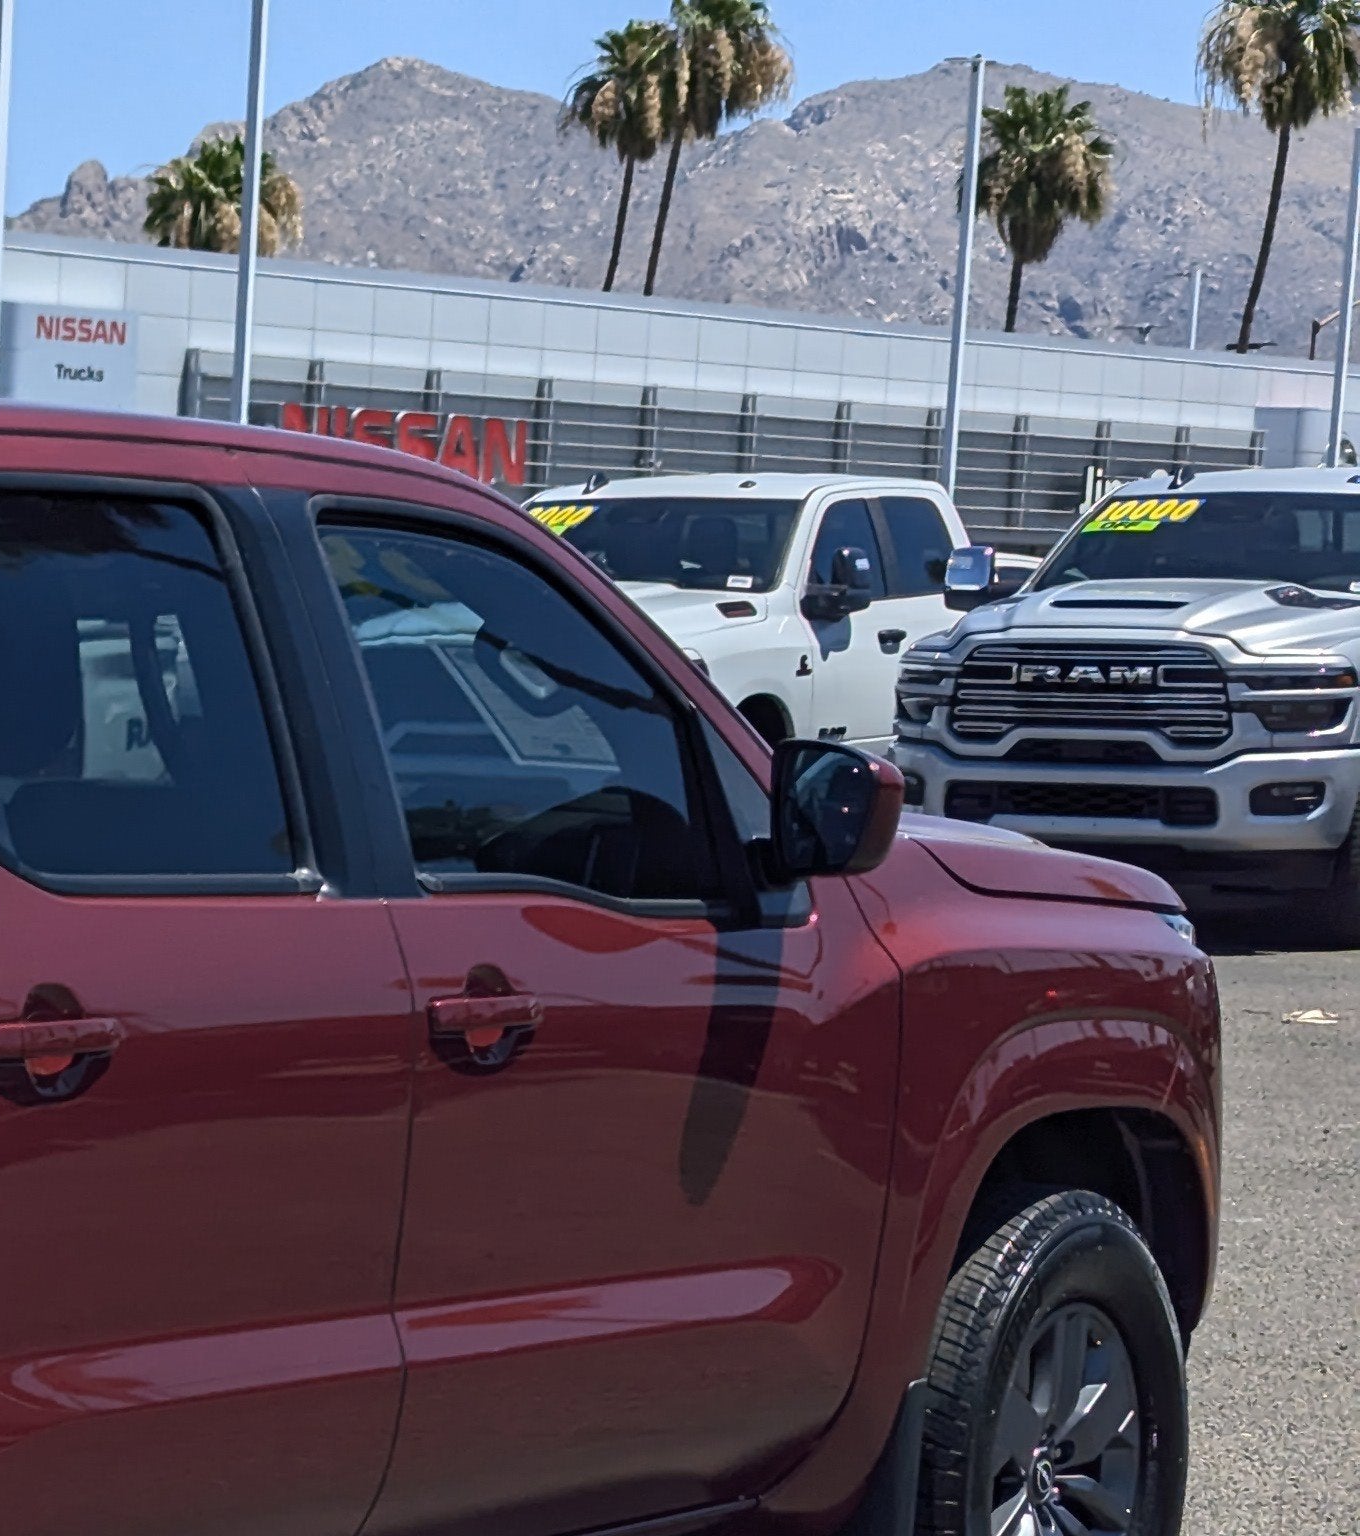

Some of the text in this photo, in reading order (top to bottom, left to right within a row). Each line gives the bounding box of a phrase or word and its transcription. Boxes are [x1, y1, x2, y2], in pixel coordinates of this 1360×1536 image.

[36, 315, 126, 346] NISSAN
[55, 363, 105, 383] Trucks
[1094, 499, 1201, 522] 10000
[1019, 664, 1154, 685] RAM
